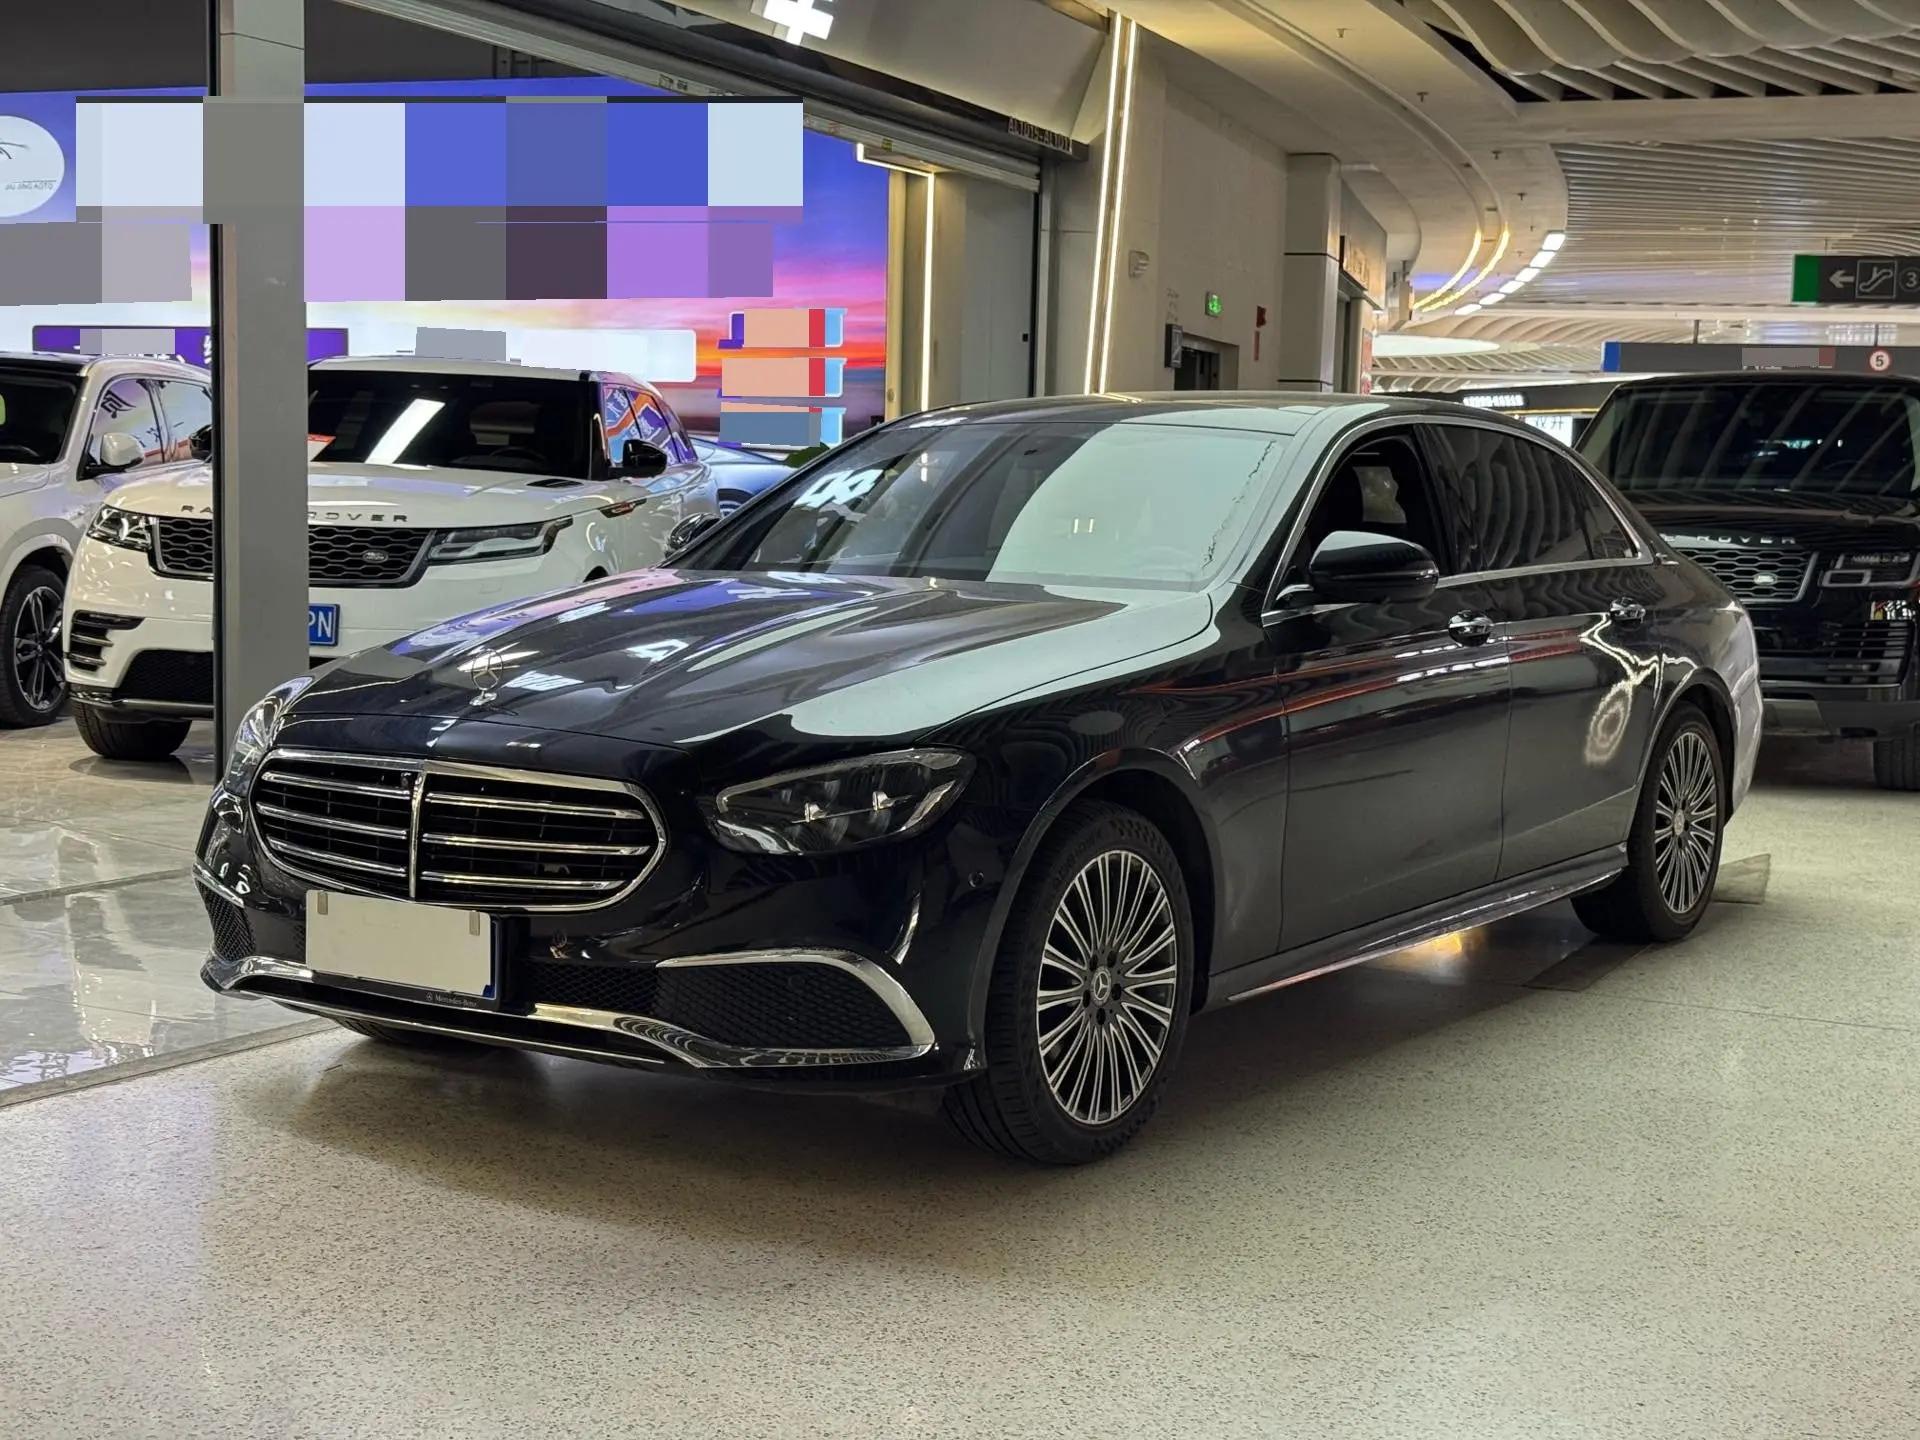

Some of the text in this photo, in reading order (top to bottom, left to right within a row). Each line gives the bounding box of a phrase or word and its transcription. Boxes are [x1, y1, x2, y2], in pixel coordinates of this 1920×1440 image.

[1906, 271, 1917, 288] 3
[1875, 354, 1884, 368] 5
[181, 505, 213, 514] RA
[308, 610, 332, 638] PN
